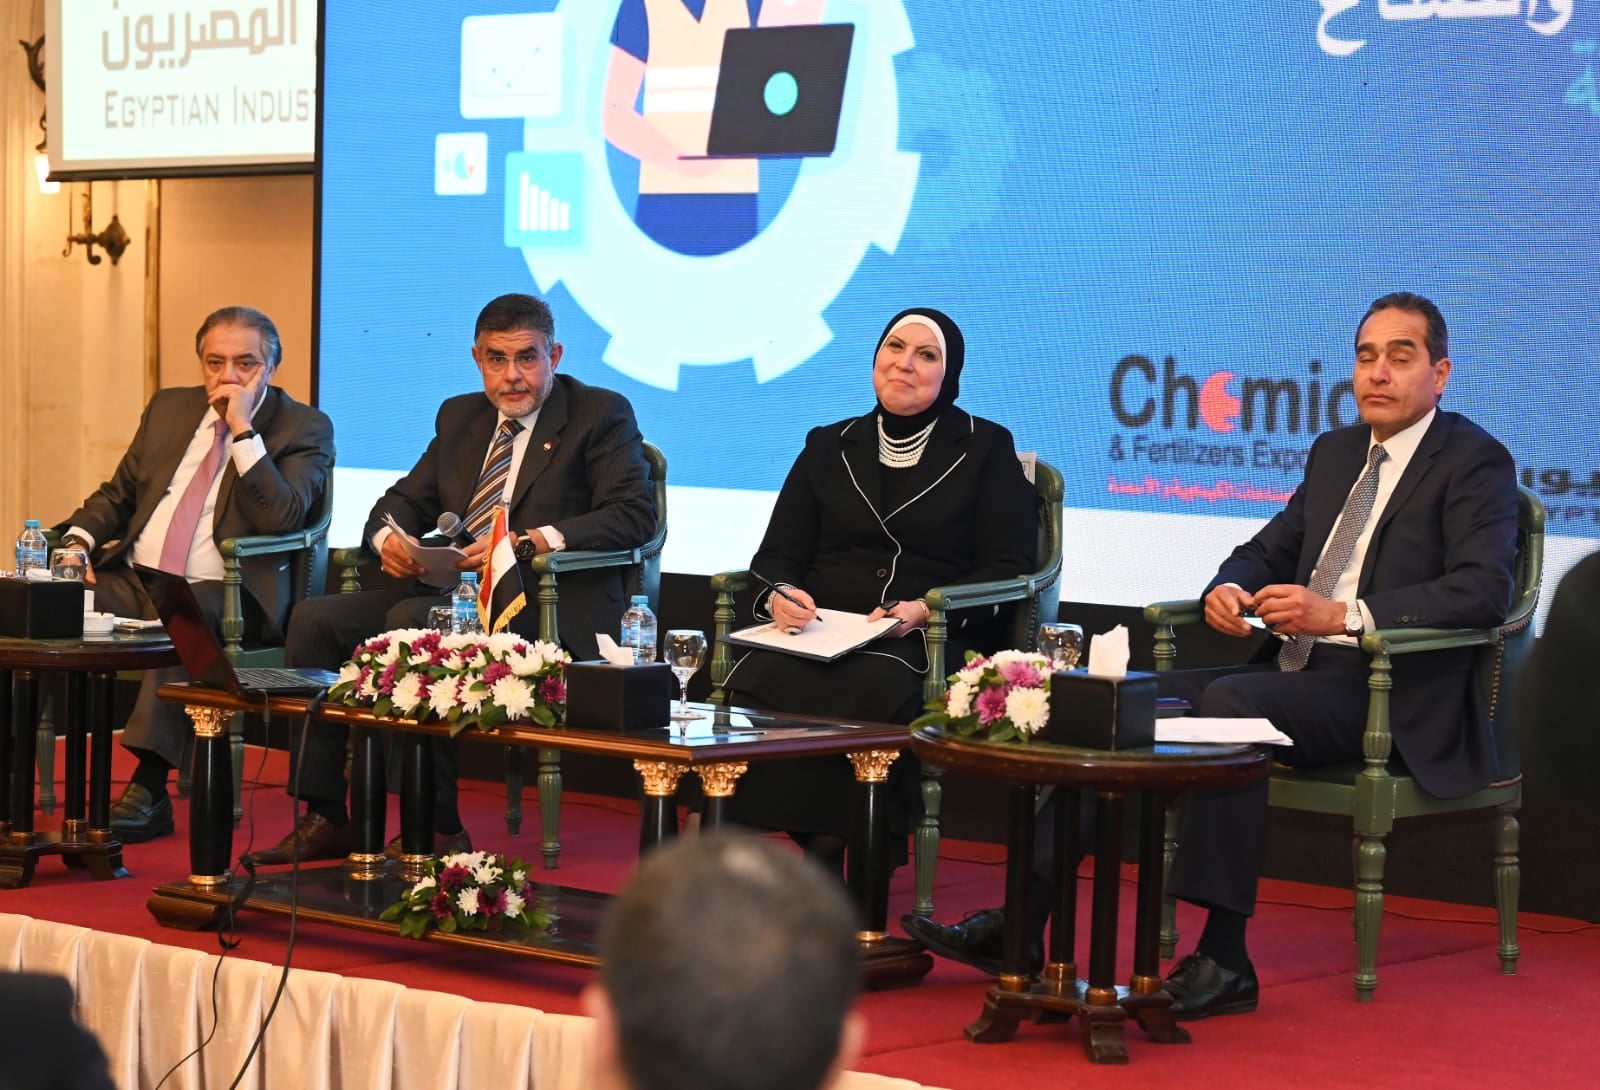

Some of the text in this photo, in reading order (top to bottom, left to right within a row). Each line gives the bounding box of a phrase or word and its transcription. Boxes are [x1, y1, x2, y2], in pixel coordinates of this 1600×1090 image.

[105, 85, 315, 128] EGYPTIAN INDUS
[1110, 354, 1363, 434] Chemic
[1110, 434, 1308, 475] & Fertilizers Expo
